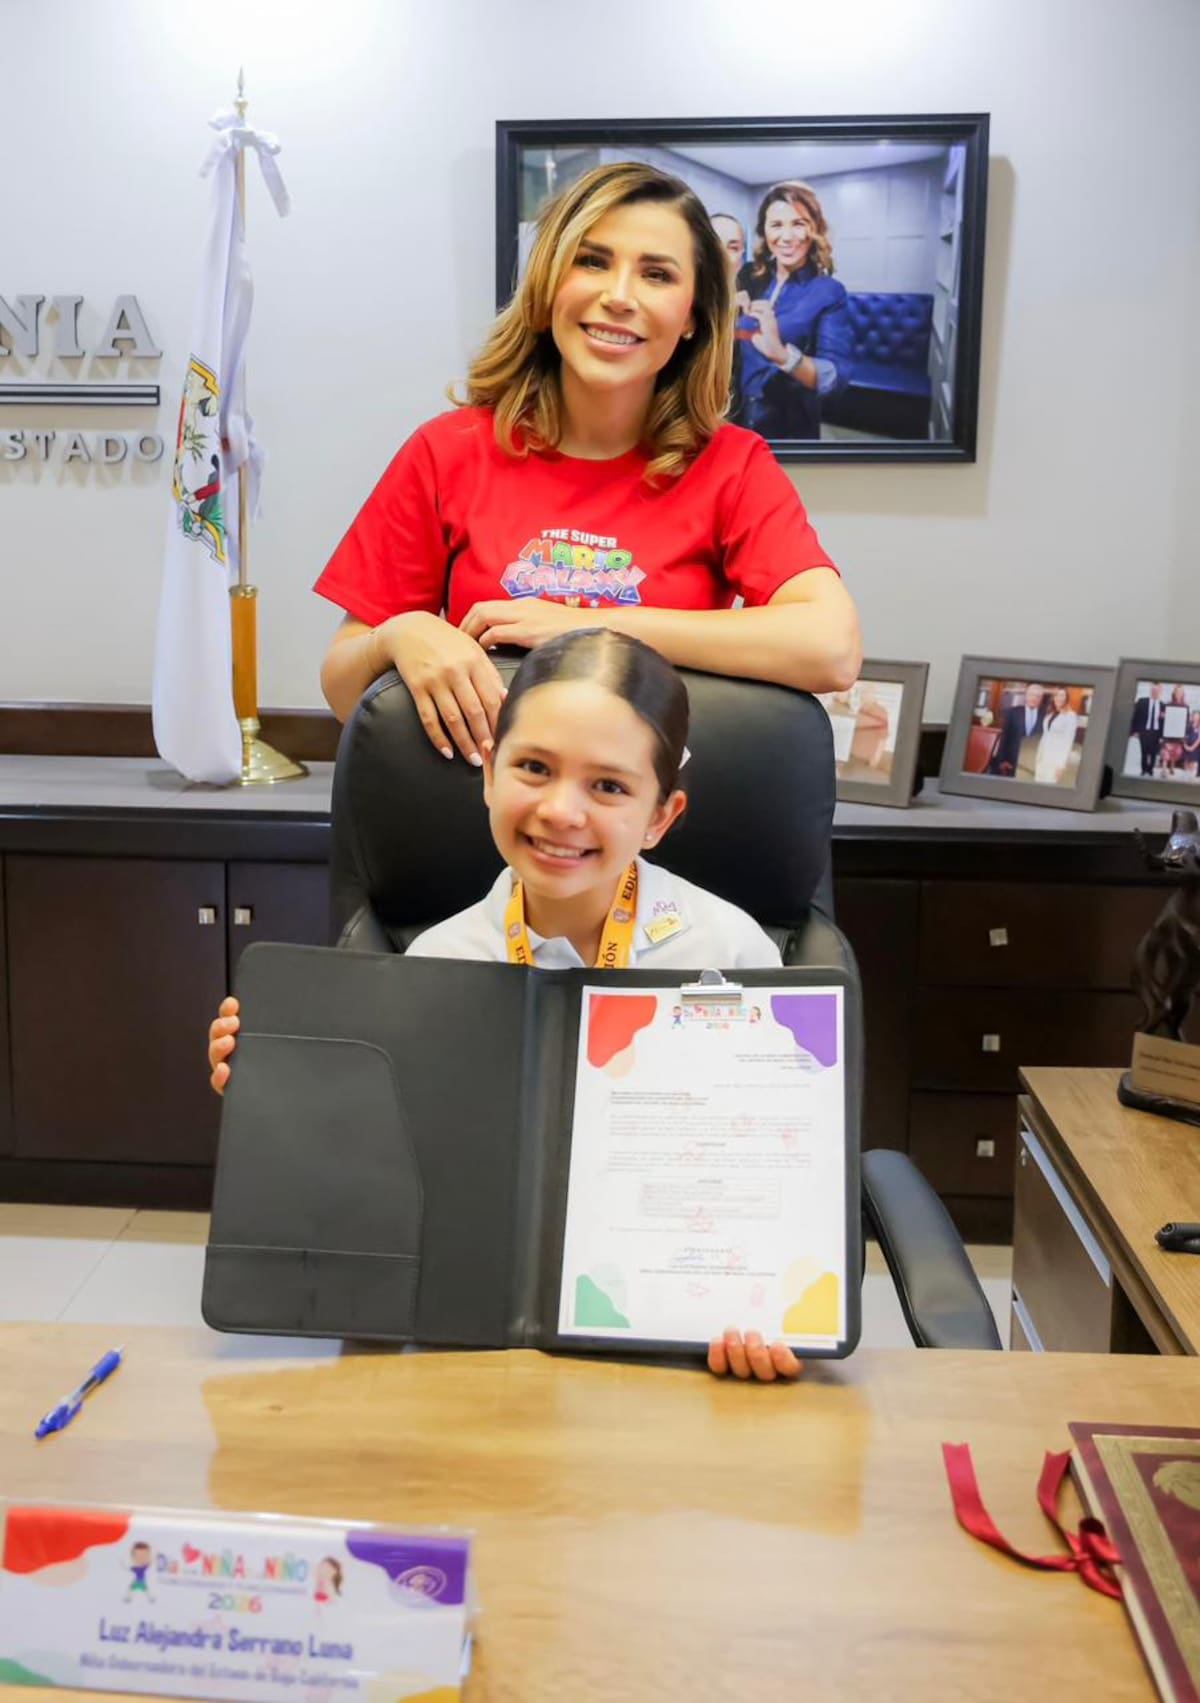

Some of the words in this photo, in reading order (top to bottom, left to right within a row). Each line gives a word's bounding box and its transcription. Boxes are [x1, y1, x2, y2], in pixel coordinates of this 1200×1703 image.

[0, 295, 163, 359] NIA
[5, 431, 164, 464] STADO
[541, 529, 569, 540] THE
[571, 530, 617, 548] SUPER
[500, 561, 648, 603] GALAXY
[99, 1617, 130, 1644] Luz
[135, 1620, 223, 1653] Alejandra
[228, 1628, 303, 1656] Serrano
[309, 1634, 353, 1660] Luna
